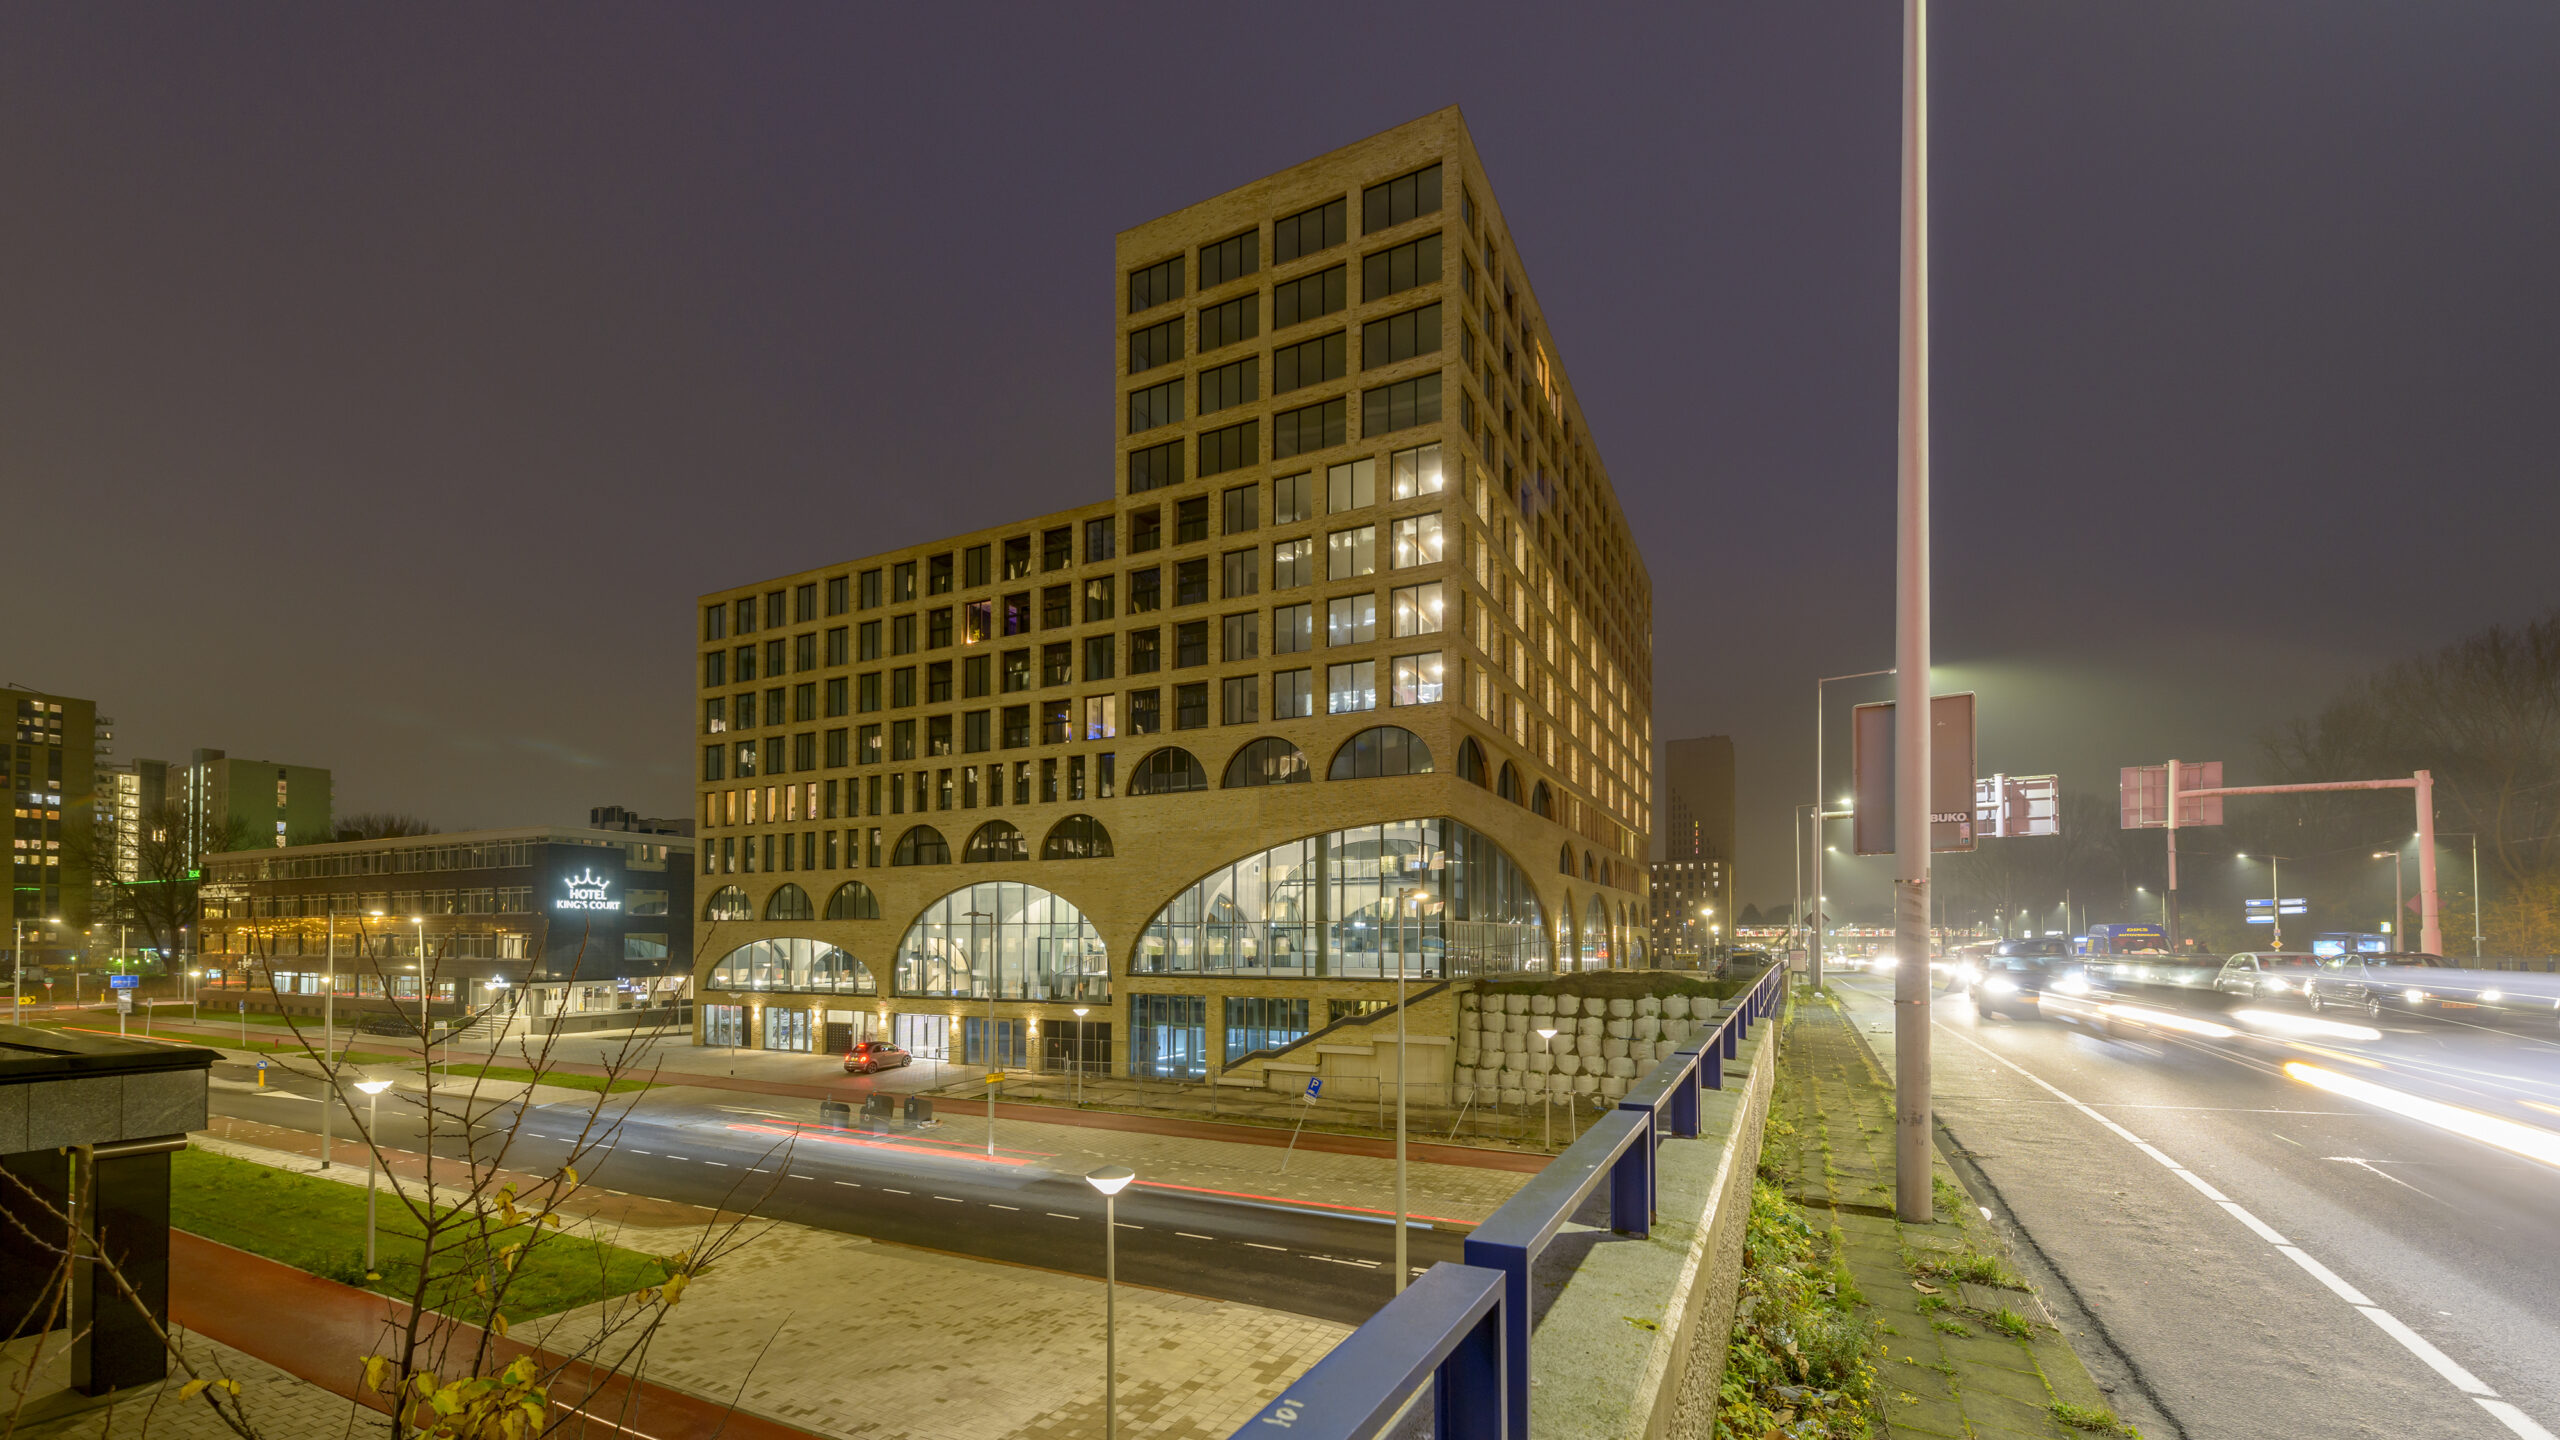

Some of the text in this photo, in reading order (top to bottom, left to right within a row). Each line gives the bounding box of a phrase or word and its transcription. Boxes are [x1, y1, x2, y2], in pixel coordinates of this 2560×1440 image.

[569, 889, 607, 900] HOTEL
[556, 900, 621, 910] KING'S COURT
[1311, 1079, 1319, 1088] P
